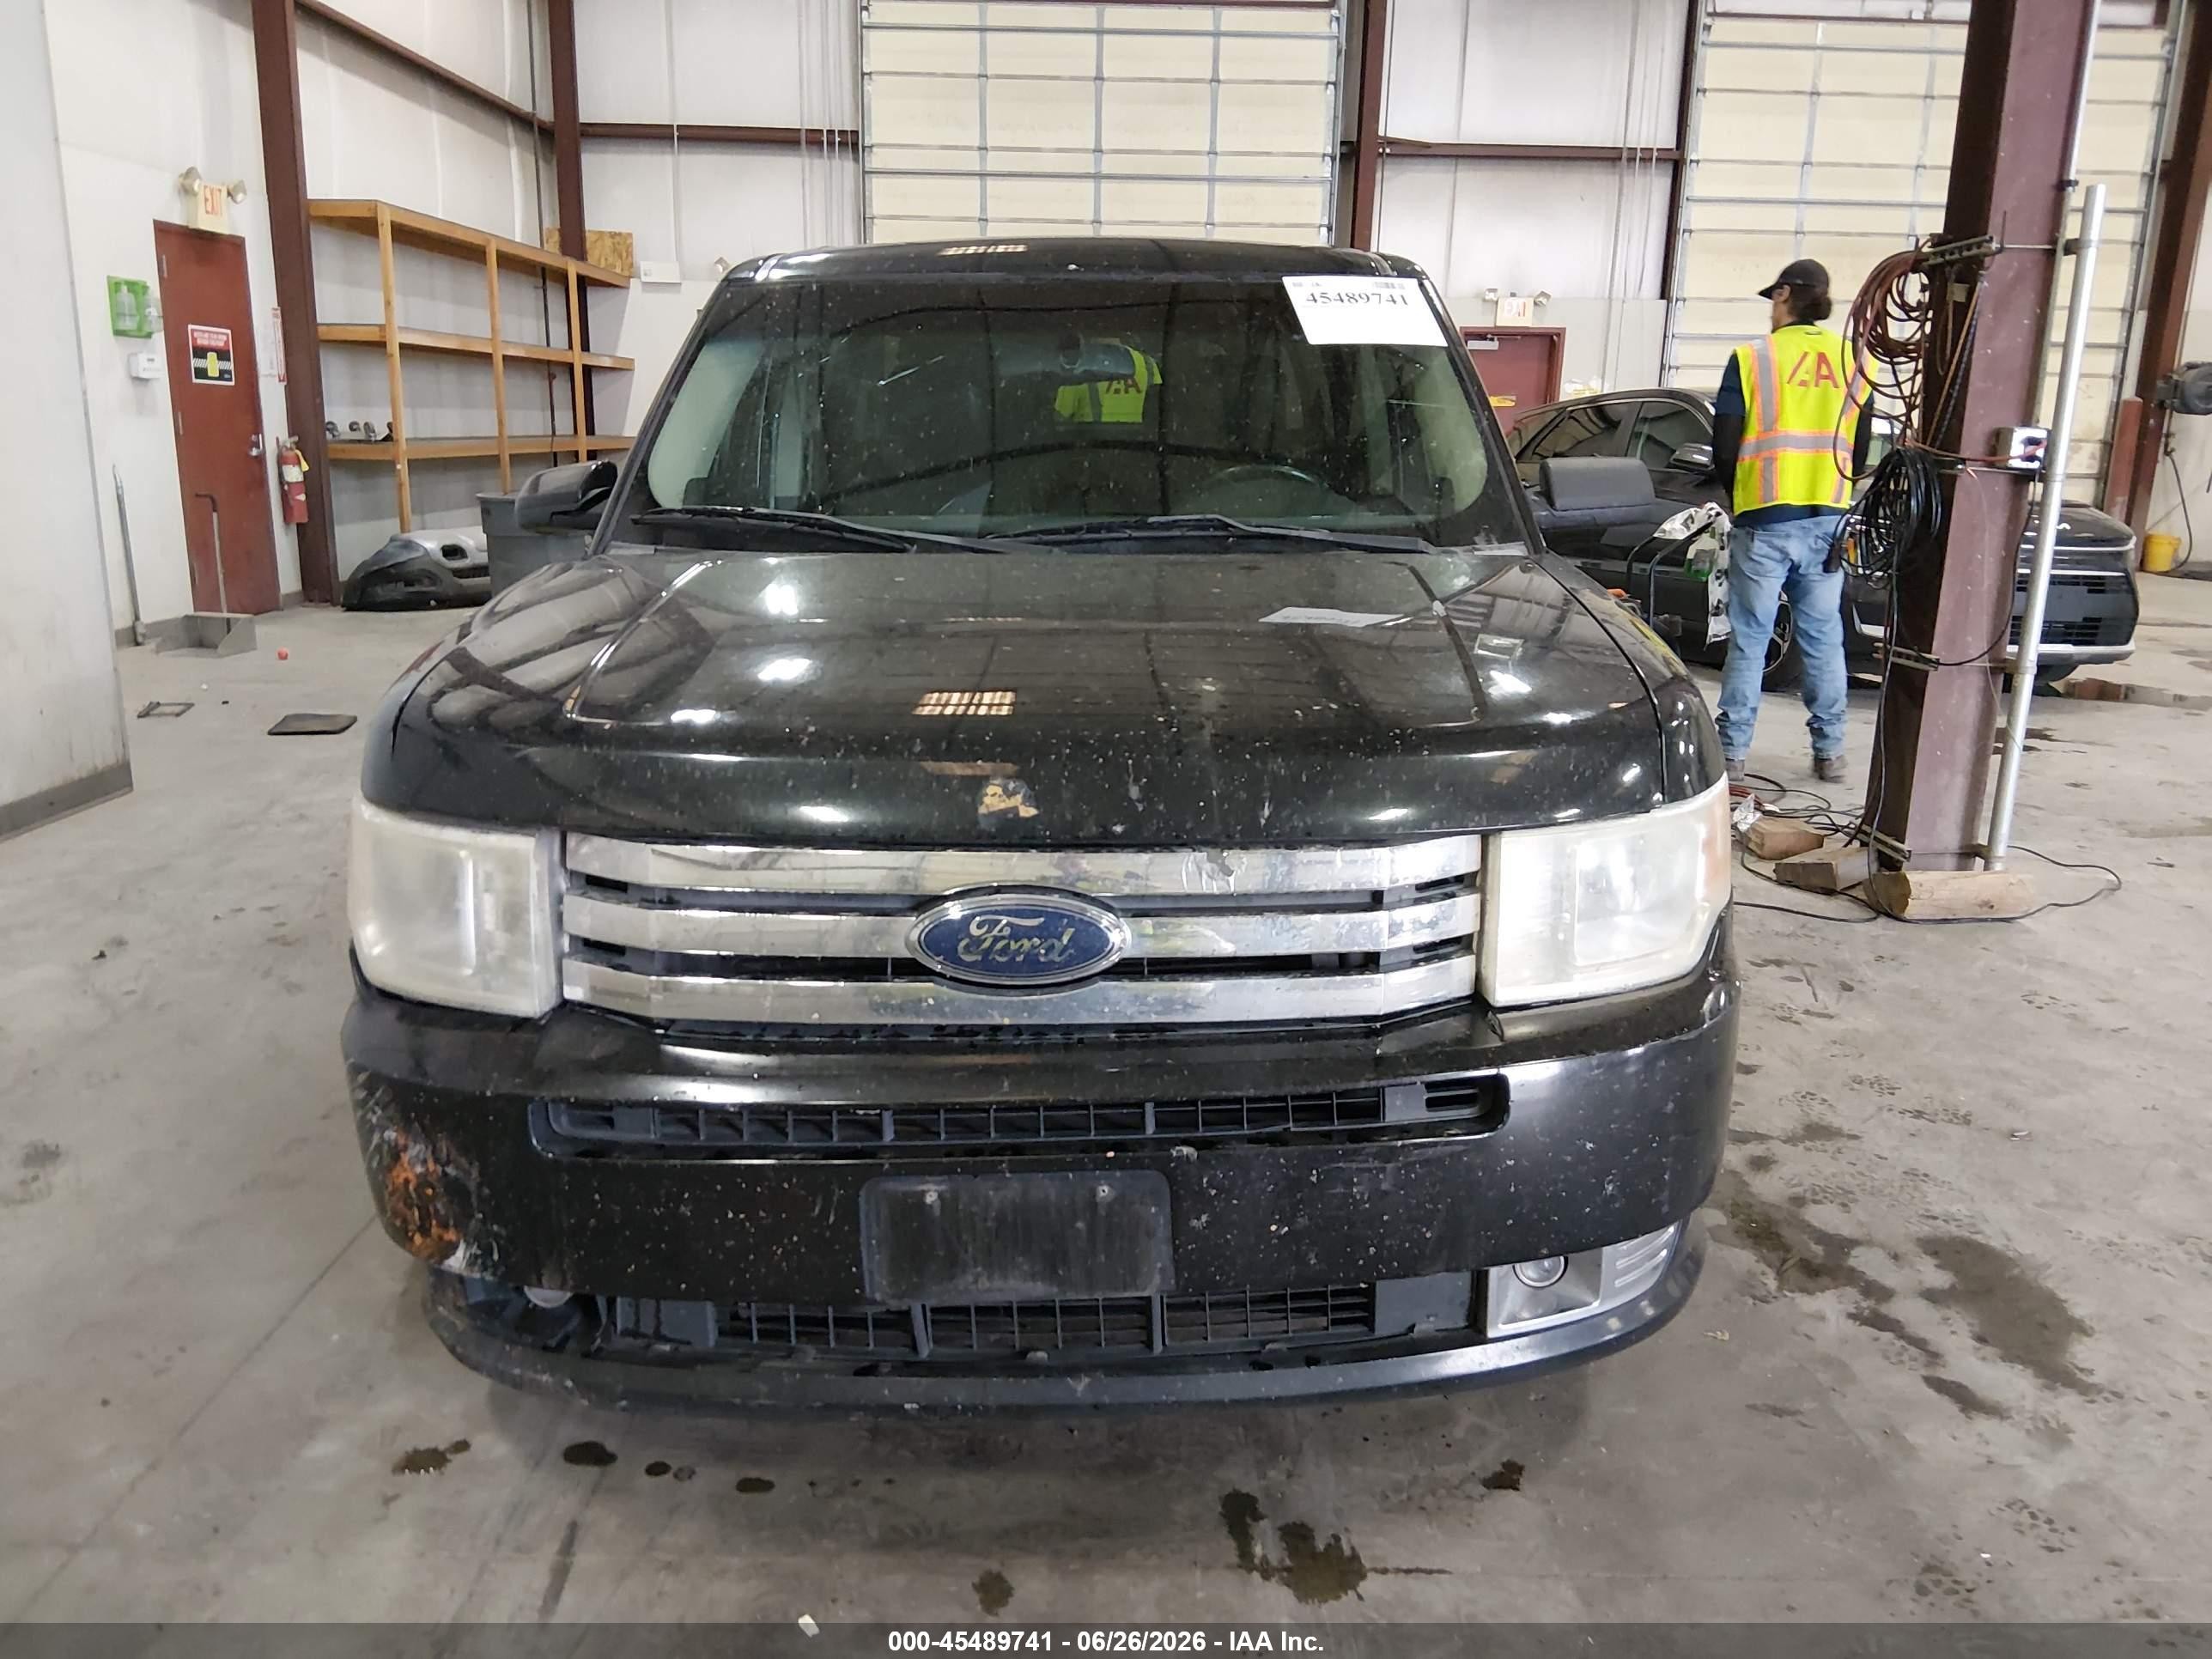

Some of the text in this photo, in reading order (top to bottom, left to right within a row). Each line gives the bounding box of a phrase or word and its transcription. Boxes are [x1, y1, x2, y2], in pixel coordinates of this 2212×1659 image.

[204, 185, 223, 216] EXIT
[1306, 292, 1409, 306] 45489741
[957, 914, 1076, 963] Ford
